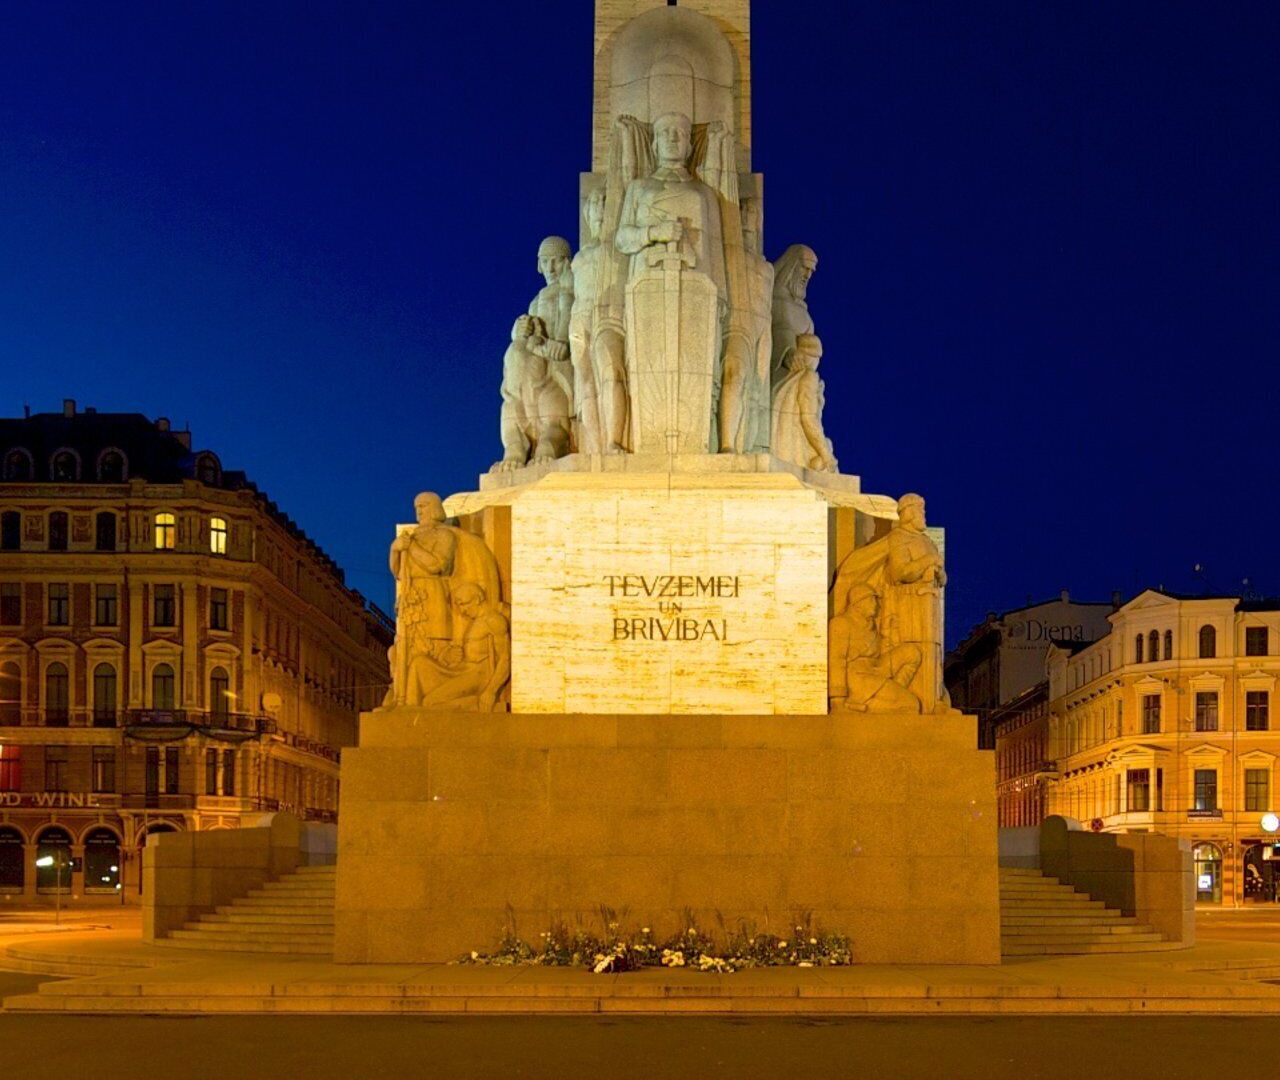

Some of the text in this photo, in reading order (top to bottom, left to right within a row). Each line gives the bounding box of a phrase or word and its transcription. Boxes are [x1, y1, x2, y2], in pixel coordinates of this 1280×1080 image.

[658, 601, 683, 614] UN
[1025, 619, 1084, 641] Diena
[34, 791, 99, 808] WINE
